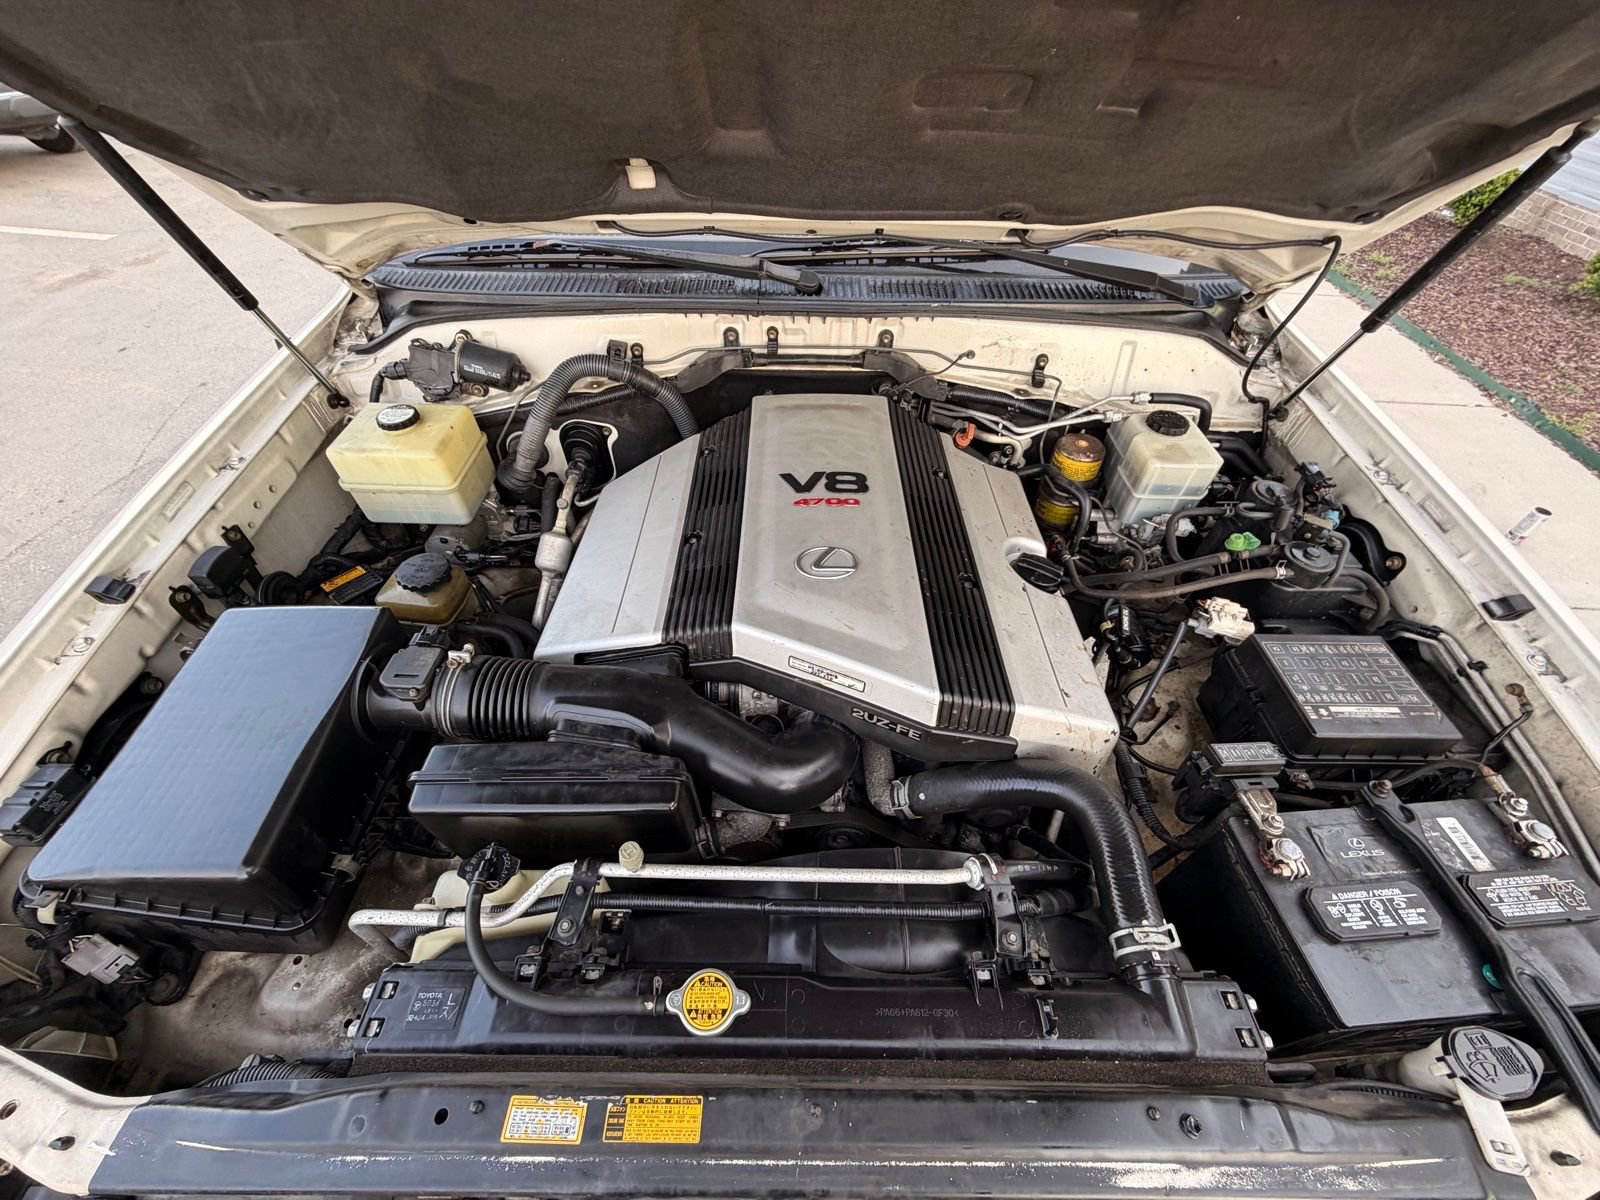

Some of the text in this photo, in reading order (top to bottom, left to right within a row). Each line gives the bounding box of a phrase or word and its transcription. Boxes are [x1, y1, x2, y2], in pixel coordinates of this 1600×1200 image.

[778, 471, 870, 494] V8
[793, 498, 860, 507] 4700
[852, 708, 921, 740] 2UZ-FE
[1340, 849, 1385, 858] LEXUS
[1337, 891, 1369, 900] DANGER
[1374, 888, 1402, 897] POISON
